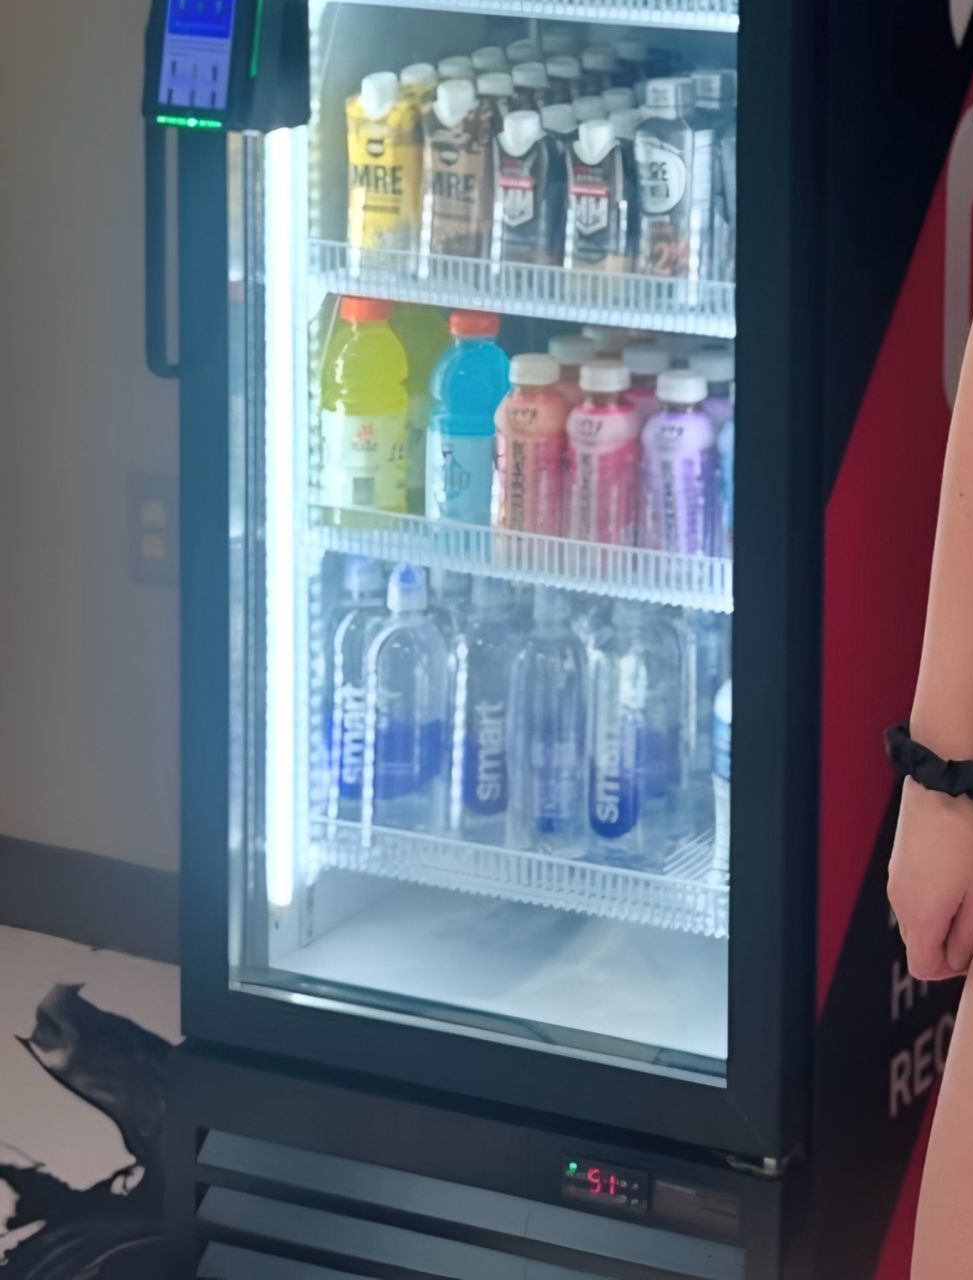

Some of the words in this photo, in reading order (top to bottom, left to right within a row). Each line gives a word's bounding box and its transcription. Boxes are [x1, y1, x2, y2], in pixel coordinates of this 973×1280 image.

[353, 164, 403, 196] MRE
[343, 682, 367, 785] smart
[475, 700, 504, 801] smart
